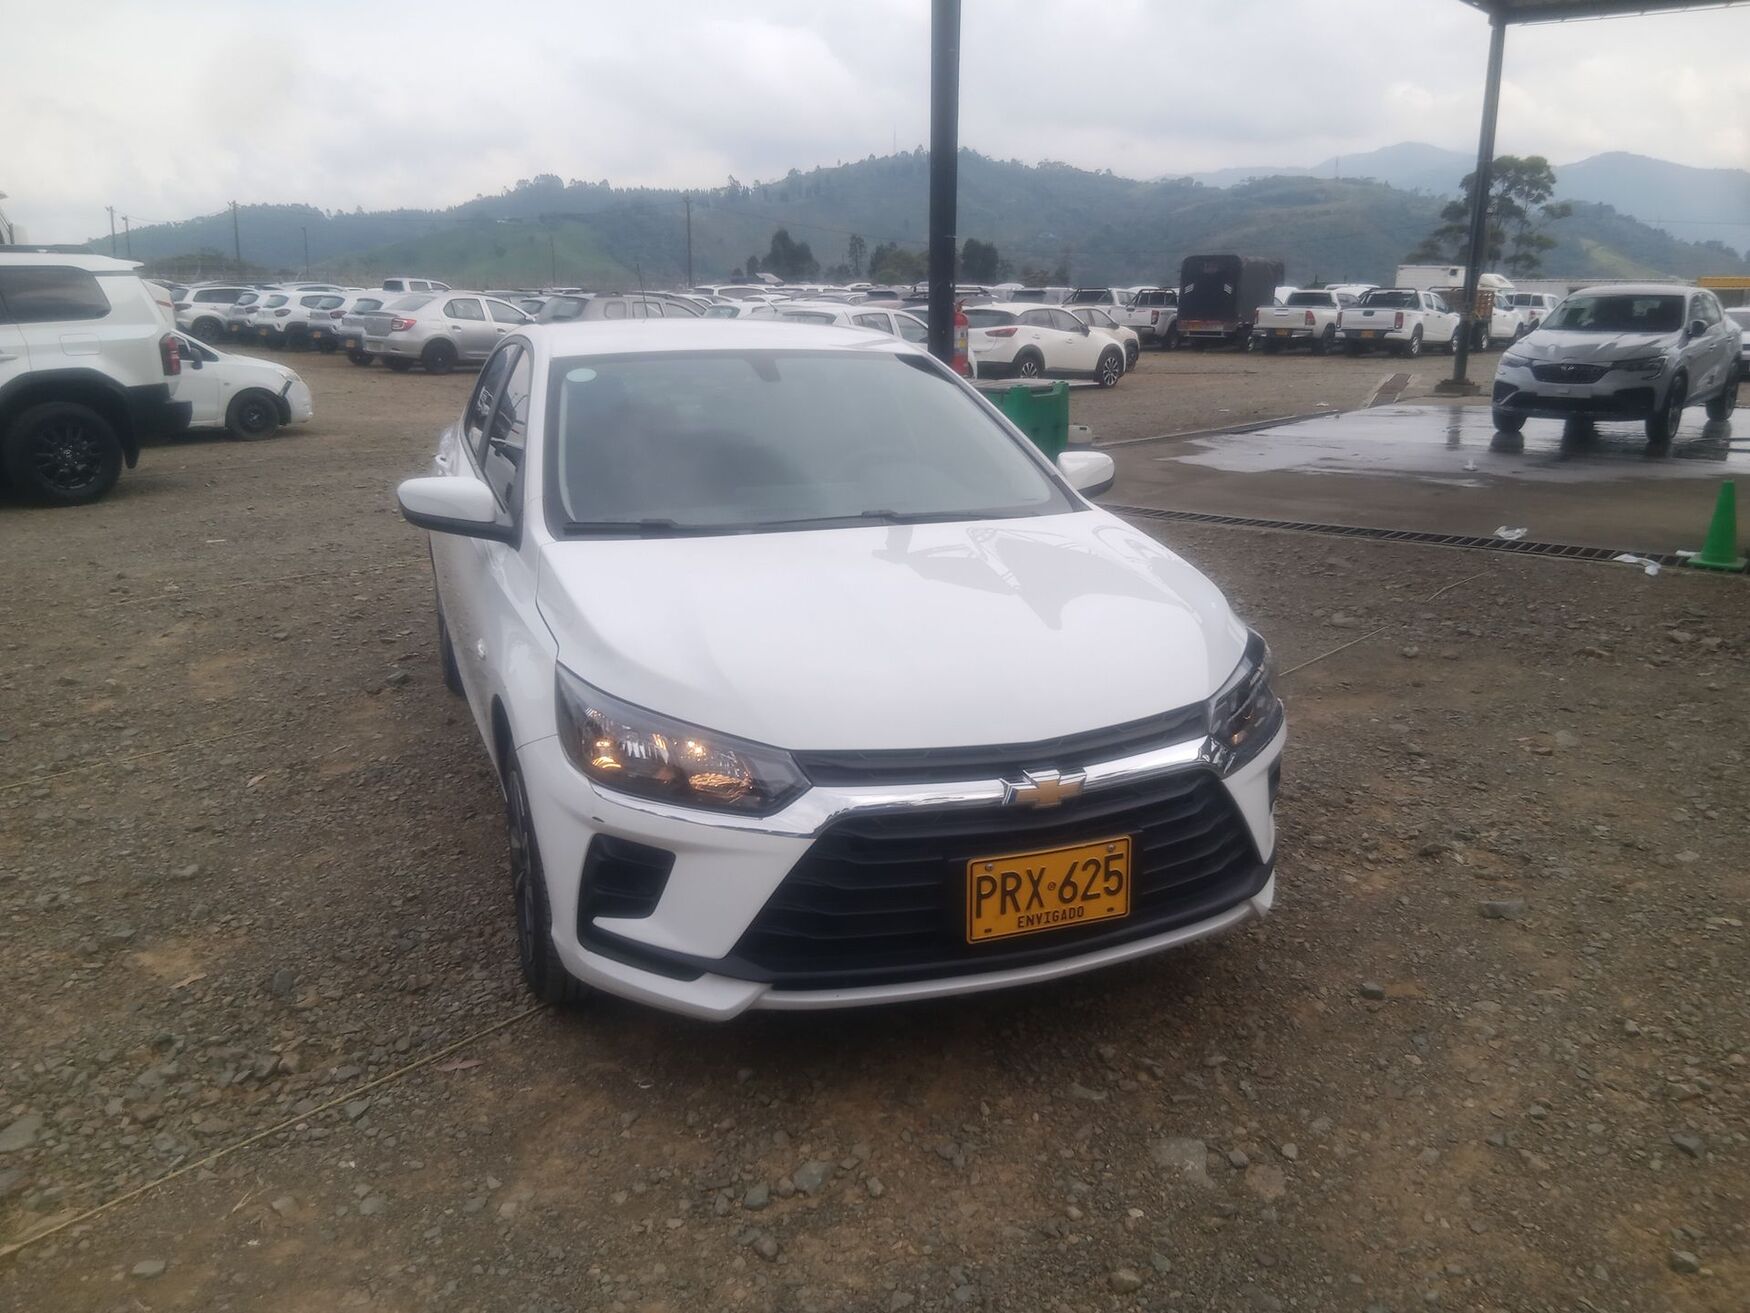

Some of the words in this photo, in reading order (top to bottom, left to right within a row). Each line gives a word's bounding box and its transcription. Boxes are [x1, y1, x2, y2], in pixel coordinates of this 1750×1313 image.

[975, 867, 1046, 919] PRX
[1057, 853, 1124, 904] 625
[1017, 905, 1085, 929] ENVIGADO
